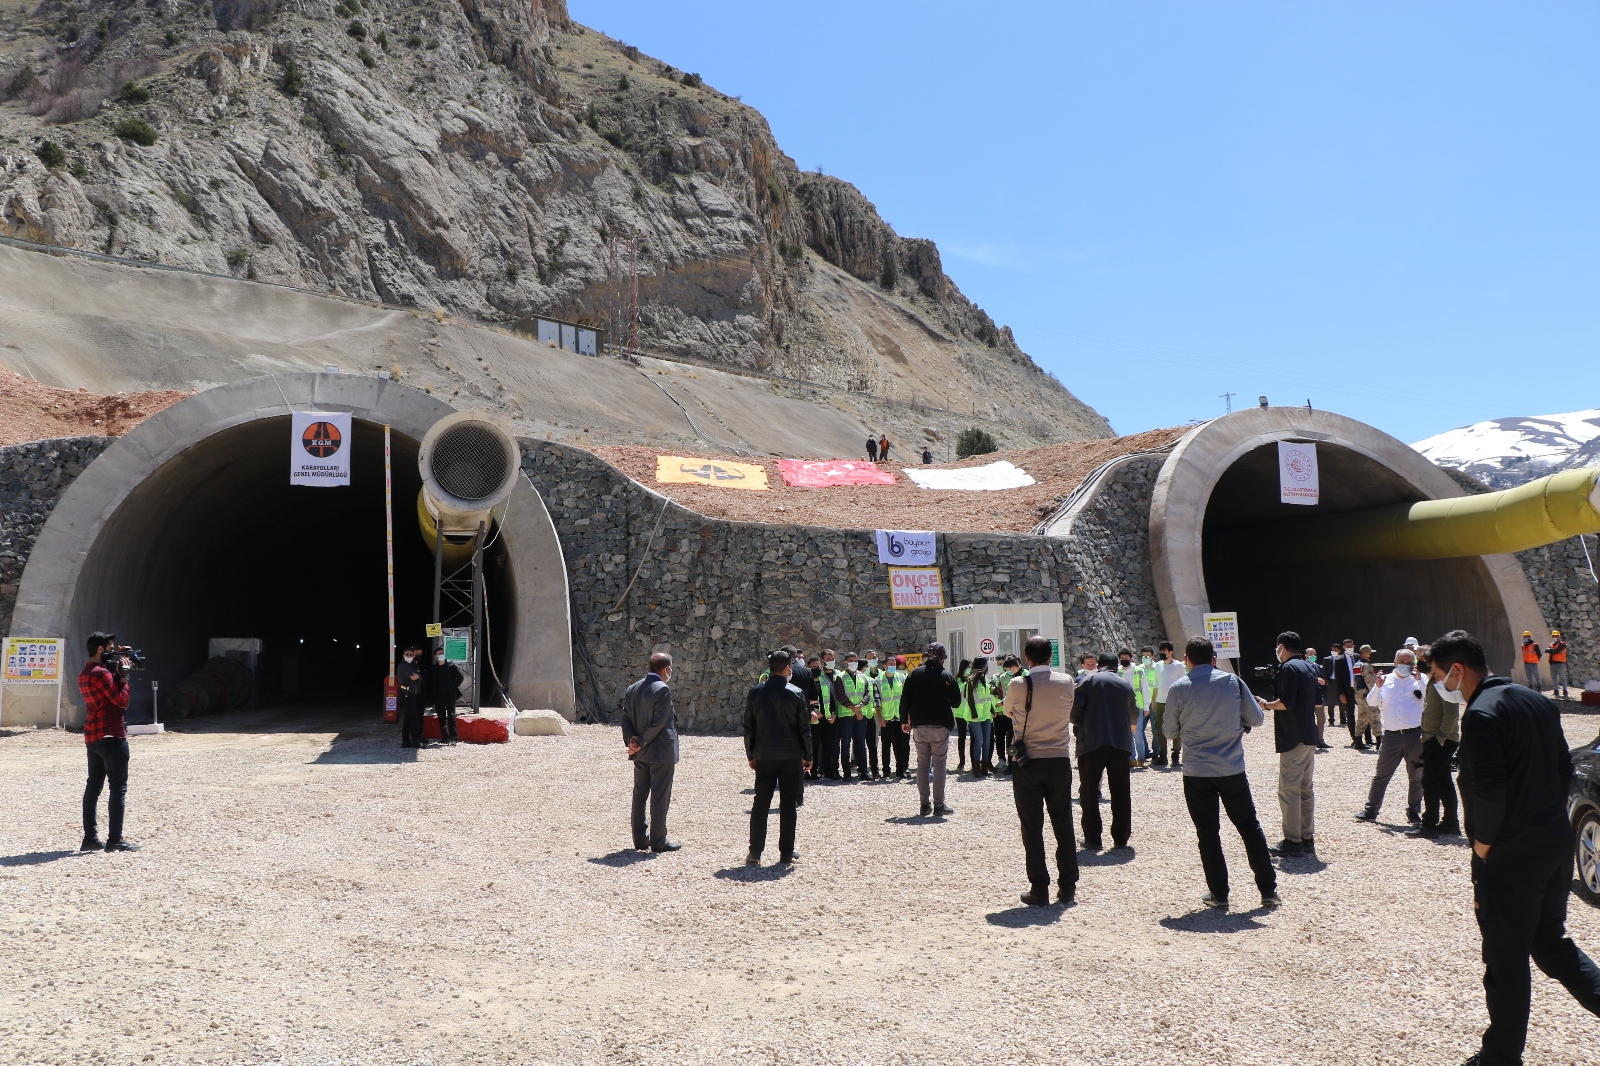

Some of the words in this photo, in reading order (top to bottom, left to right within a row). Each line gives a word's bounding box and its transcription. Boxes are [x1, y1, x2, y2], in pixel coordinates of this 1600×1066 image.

[904, 537, 931, 548] bayburt
[910, 549, 932, 557] group
[892, 570, 940, 588] ÖNCE
[983, 642, 992, 650] 20
